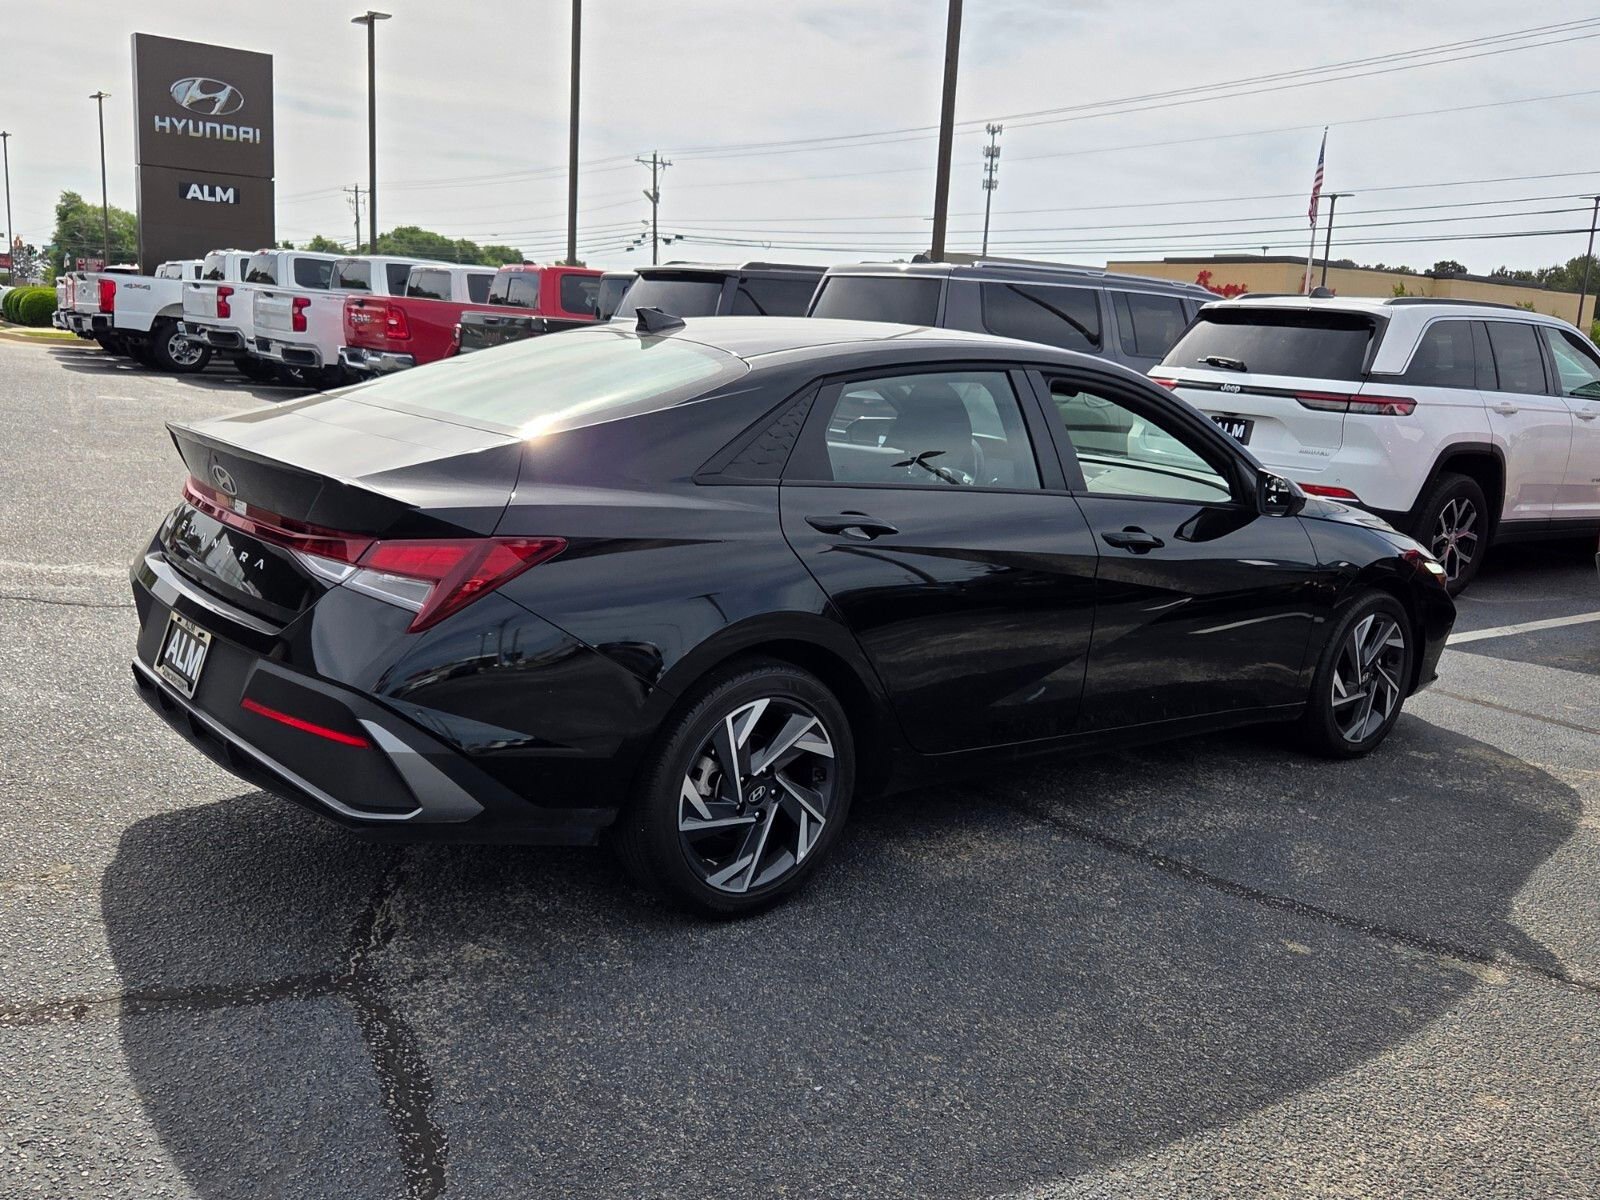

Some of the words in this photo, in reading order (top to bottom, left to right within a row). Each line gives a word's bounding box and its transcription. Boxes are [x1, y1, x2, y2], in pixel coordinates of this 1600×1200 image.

[154, 115, 261, 144] HYUNDAI
[186, 183, 234, 204] ALM
[1220, 383, 1241, 394] Jeep
[181, 520, 265, 570] ELANTRA
[164, 628, 205, 681] ALM
